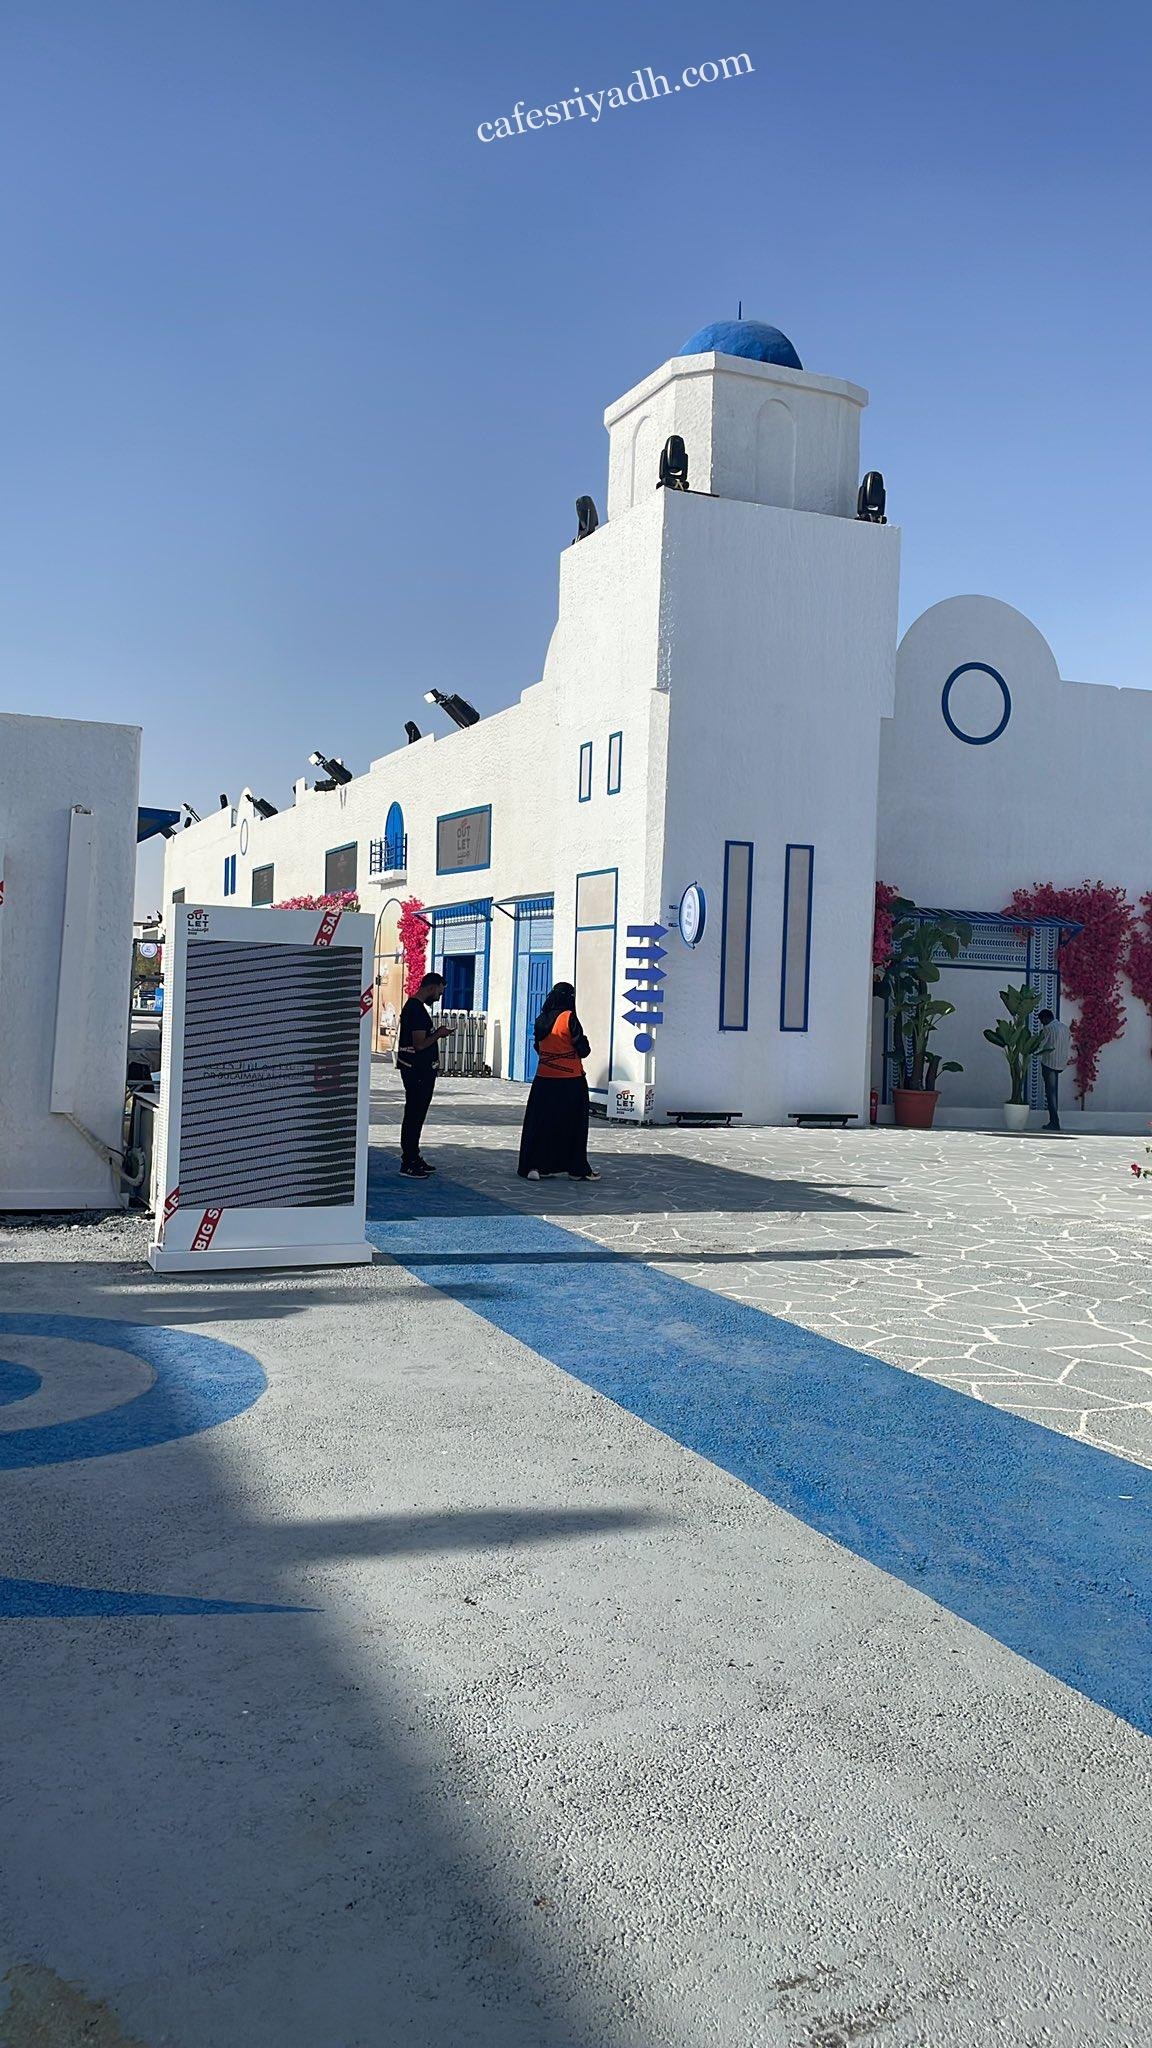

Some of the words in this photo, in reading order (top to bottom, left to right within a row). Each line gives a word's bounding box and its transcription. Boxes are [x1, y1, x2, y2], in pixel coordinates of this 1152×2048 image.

[187, 913, 210, 921] OUT
[187, 920, 209, 928] LET
[616, 1093, 635, 1101] OUT
[163, 1194, 180, 1218] LE
[194, 1223, 213, 1250] BIG
